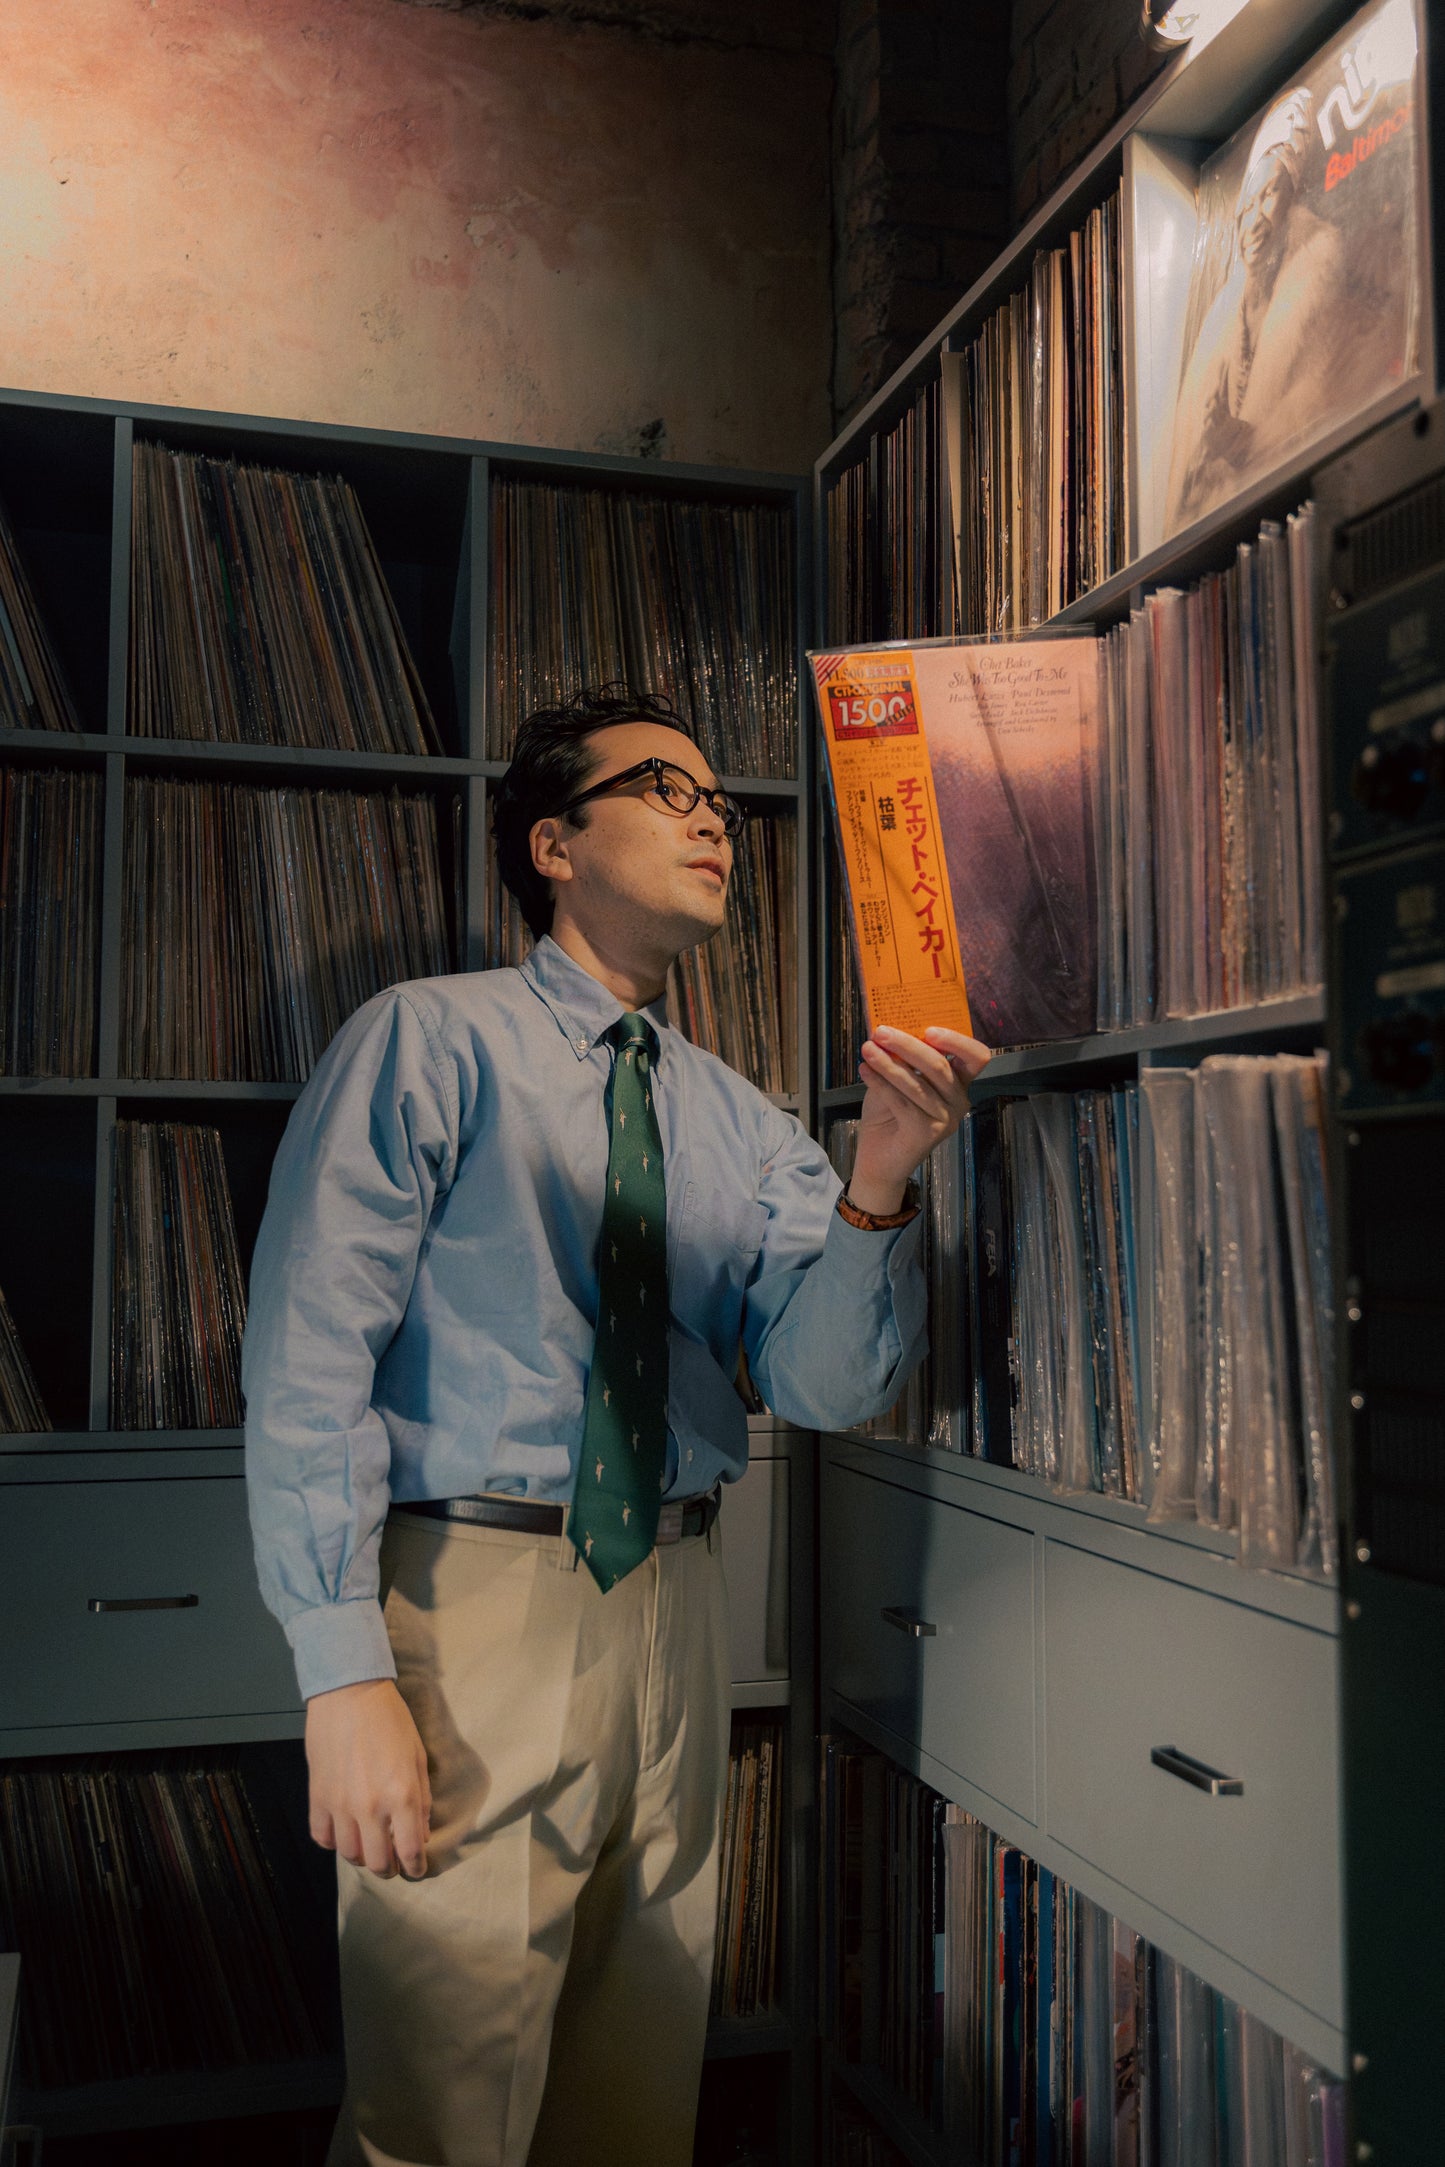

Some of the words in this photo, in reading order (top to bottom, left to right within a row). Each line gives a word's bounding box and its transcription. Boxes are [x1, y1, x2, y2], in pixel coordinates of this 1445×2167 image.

[980, 657, 1001, 670] Chet
[1006, 657, 1032, 669] Baker
[838, 696, 907, 727] 1500
[878, 796, 897, 831] 枯葉
[897, 777, 945, 979] チェット・ベイカー
